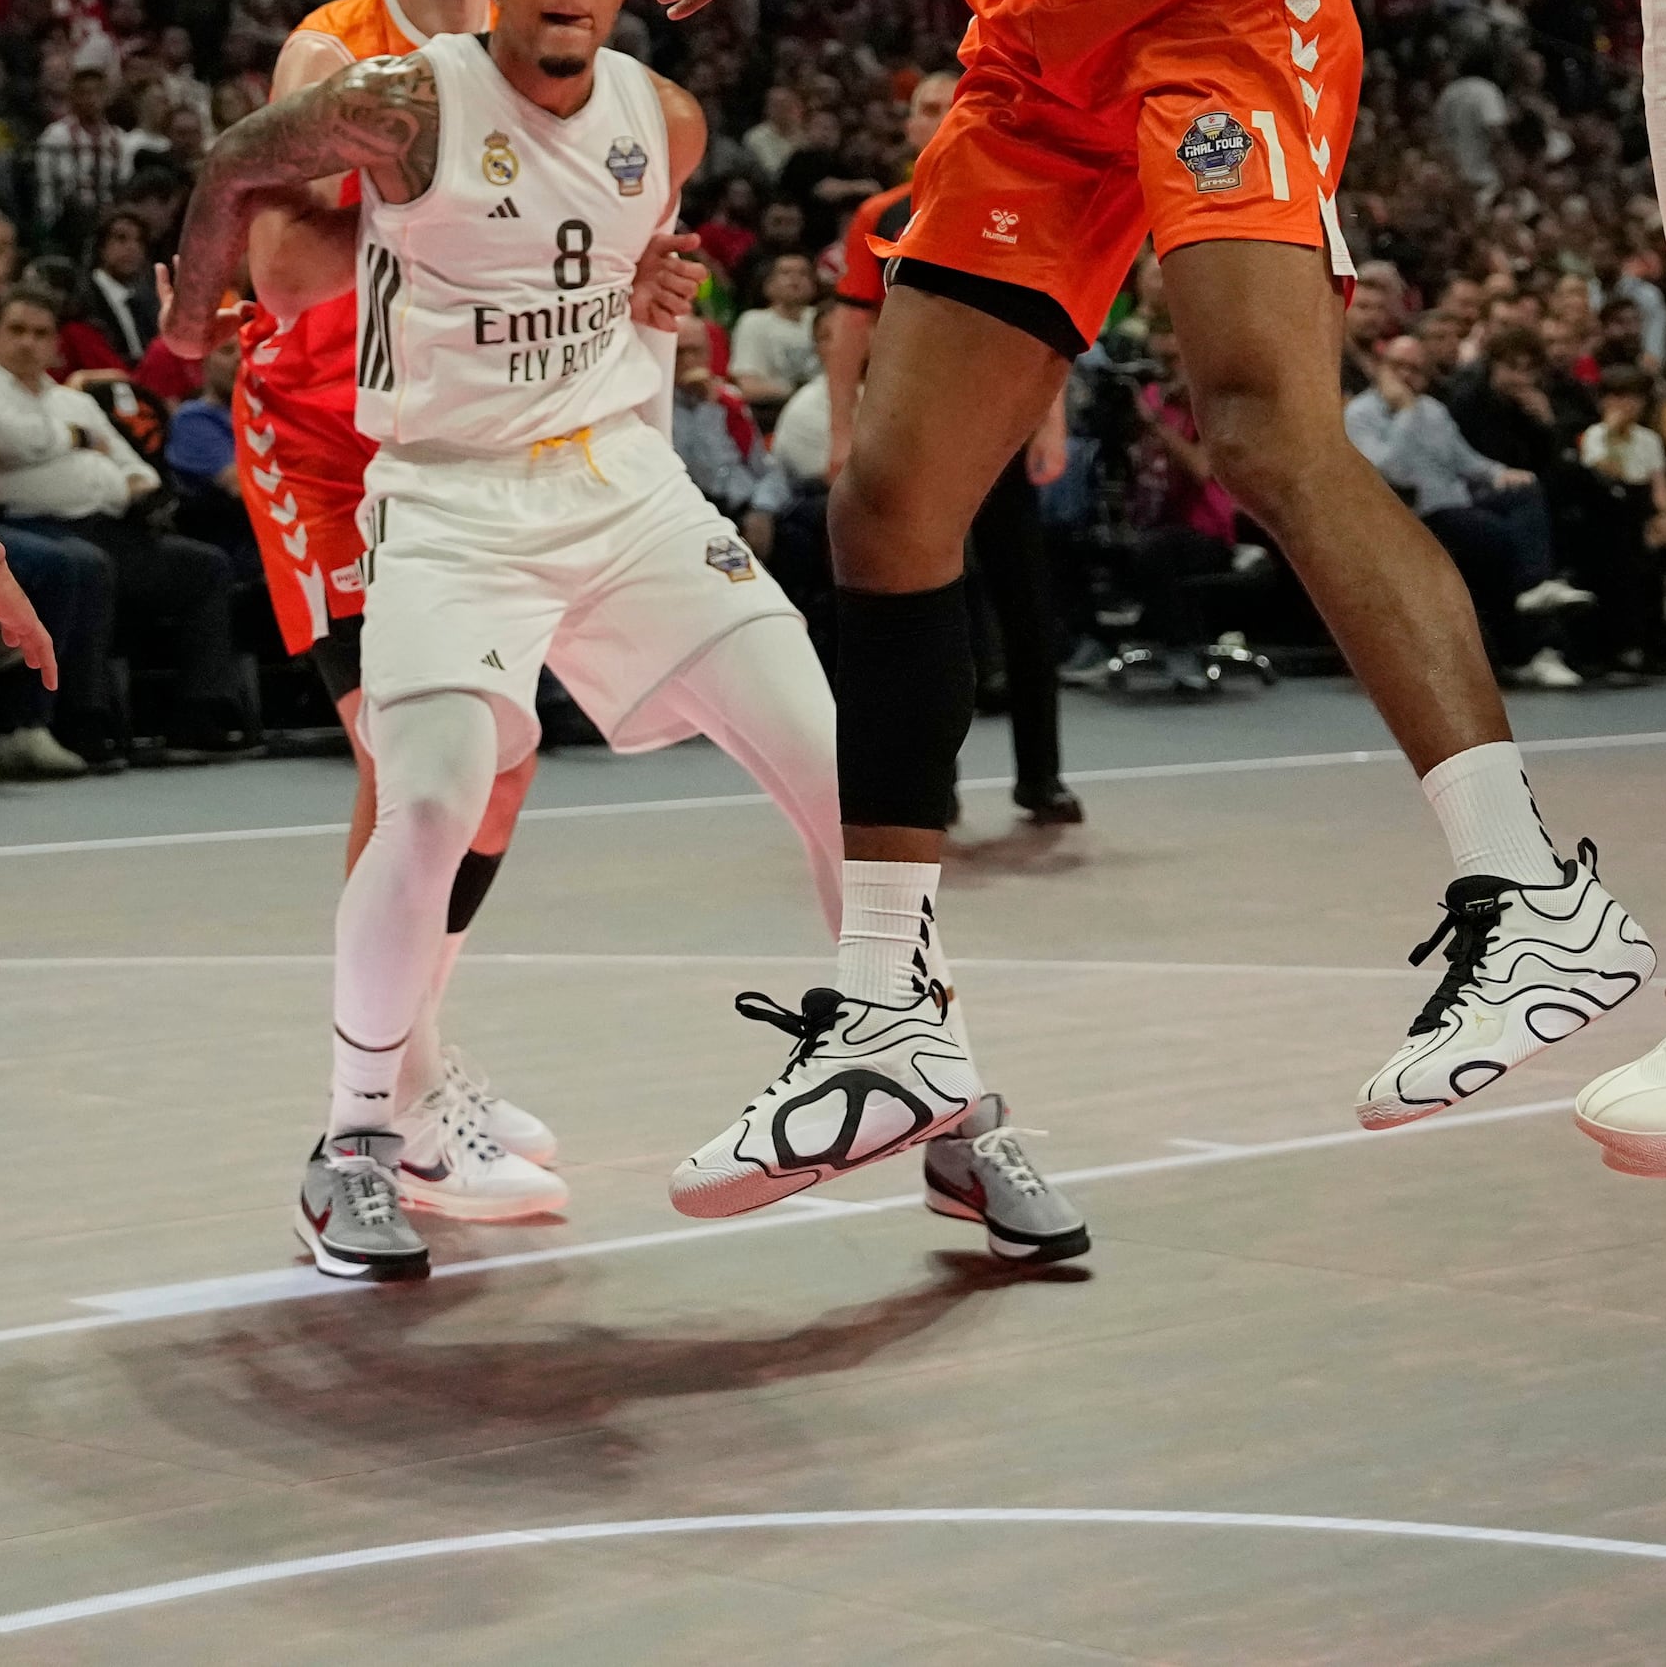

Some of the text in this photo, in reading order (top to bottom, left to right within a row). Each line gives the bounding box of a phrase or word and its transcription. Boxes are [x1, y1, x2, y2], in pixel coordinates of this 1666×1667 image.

[1184, 136, 1244, 158] FINAL FOUR
[1251, 109, 1290, 202] 1
[553, 219, 593, 290] 8
[509, 347, 550, 383] FLY
